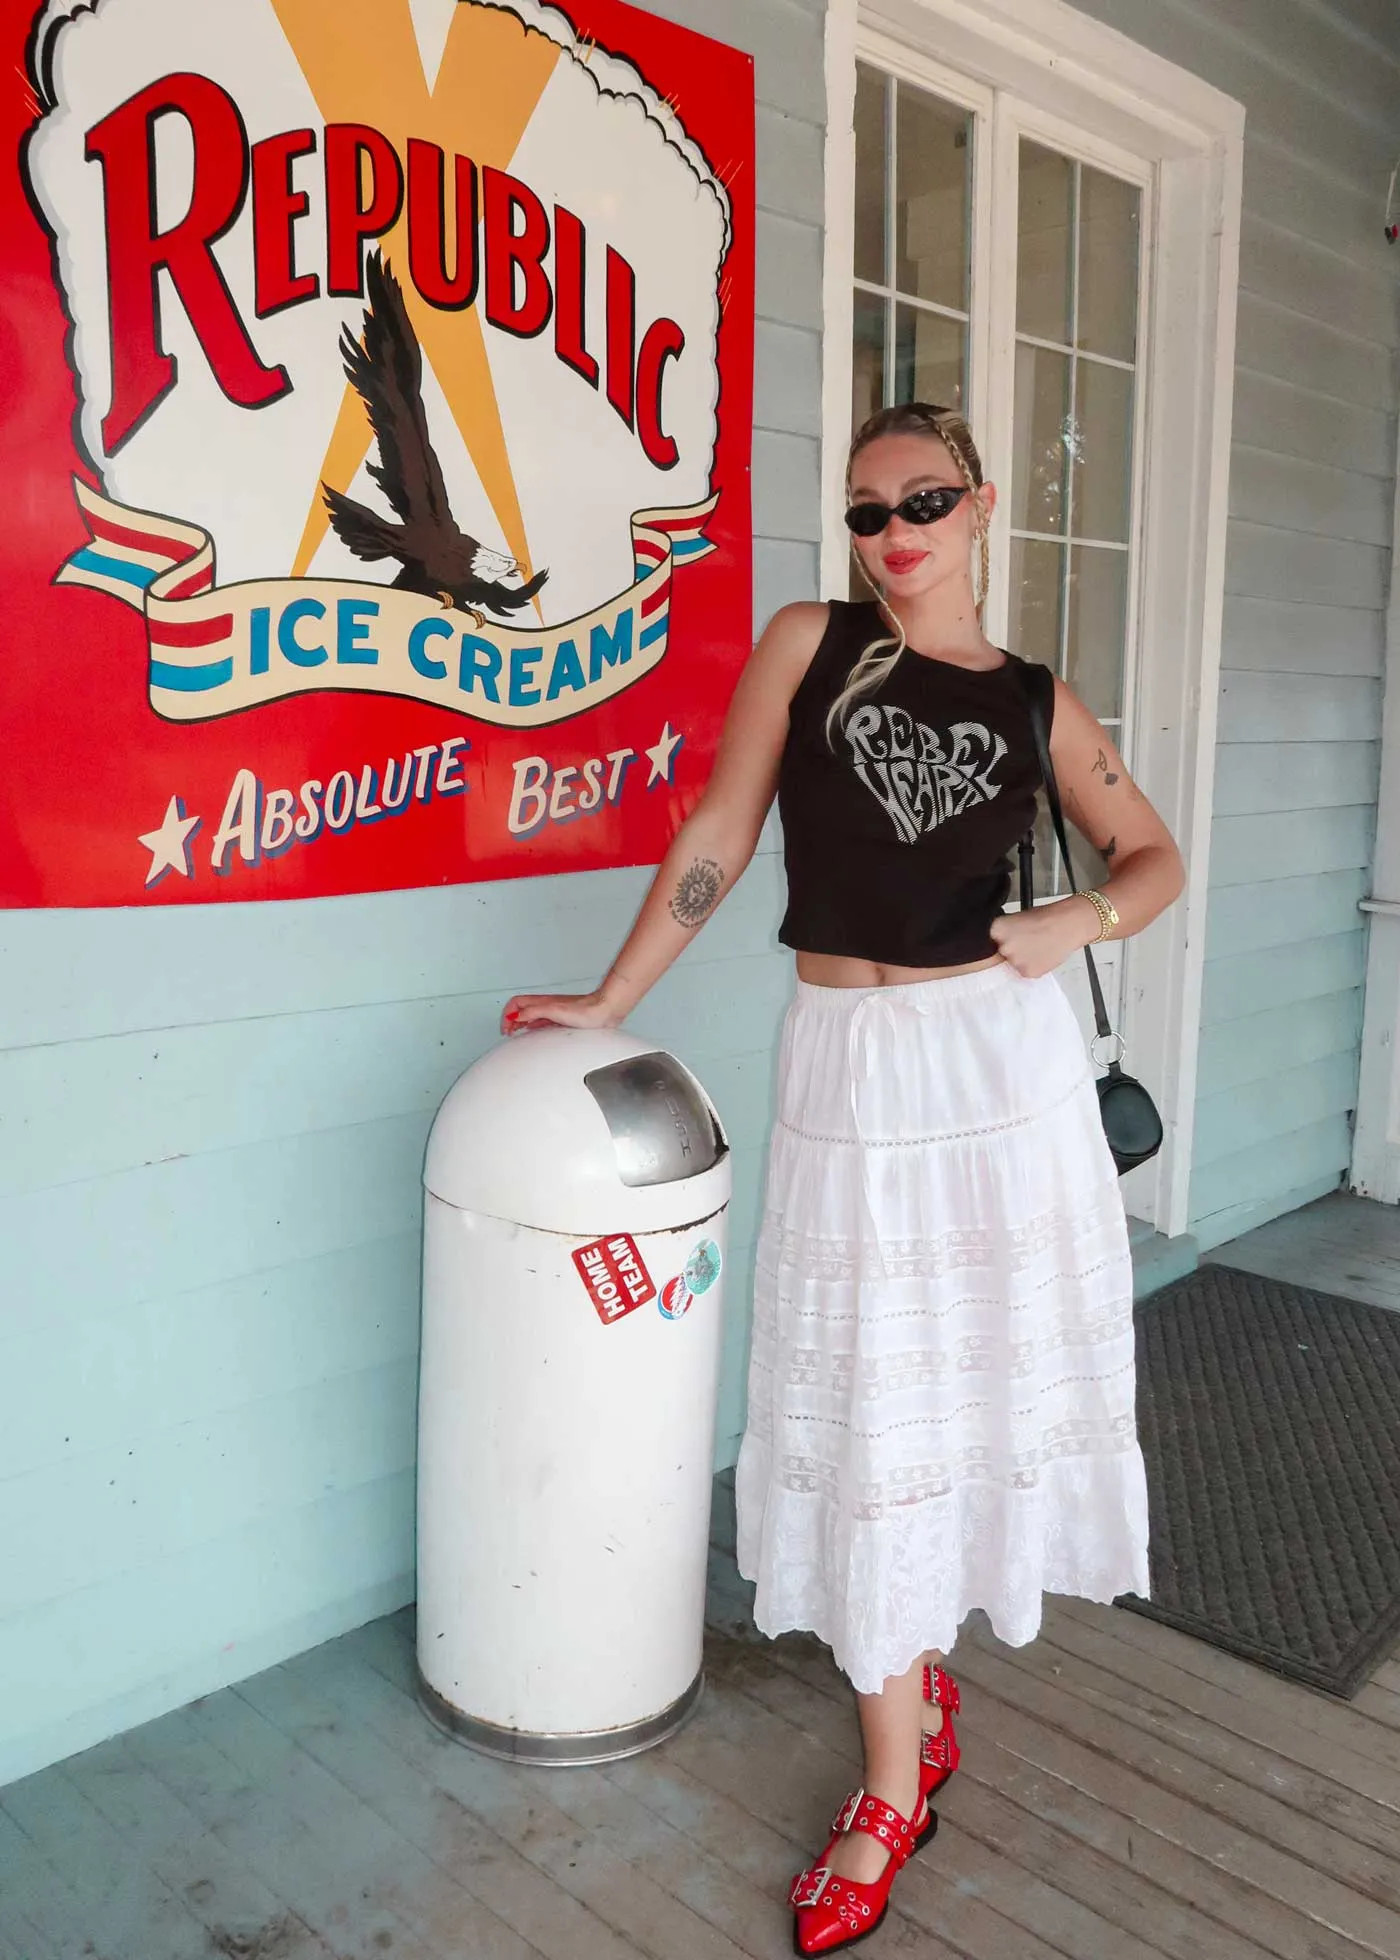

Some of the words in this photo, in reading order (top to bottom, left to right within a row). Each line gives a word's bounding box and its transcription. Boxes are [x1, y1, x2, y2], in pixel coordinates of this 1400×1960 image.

[84, 71, 687, 472] REPUBLIC
[249, 597, 379, 677] ICE
[407, 609, 635, 707] CREAM
[844, 704, 1009, 801] REBEL
[210, 736, 473, 876] ABSOLUTE
[507, 747, 638, 840] BEST
[853, 762, 985, 845] HEART
[580, 1245, 626, 1319] HOME
[606, 1235, 650, 1304] TEAM
